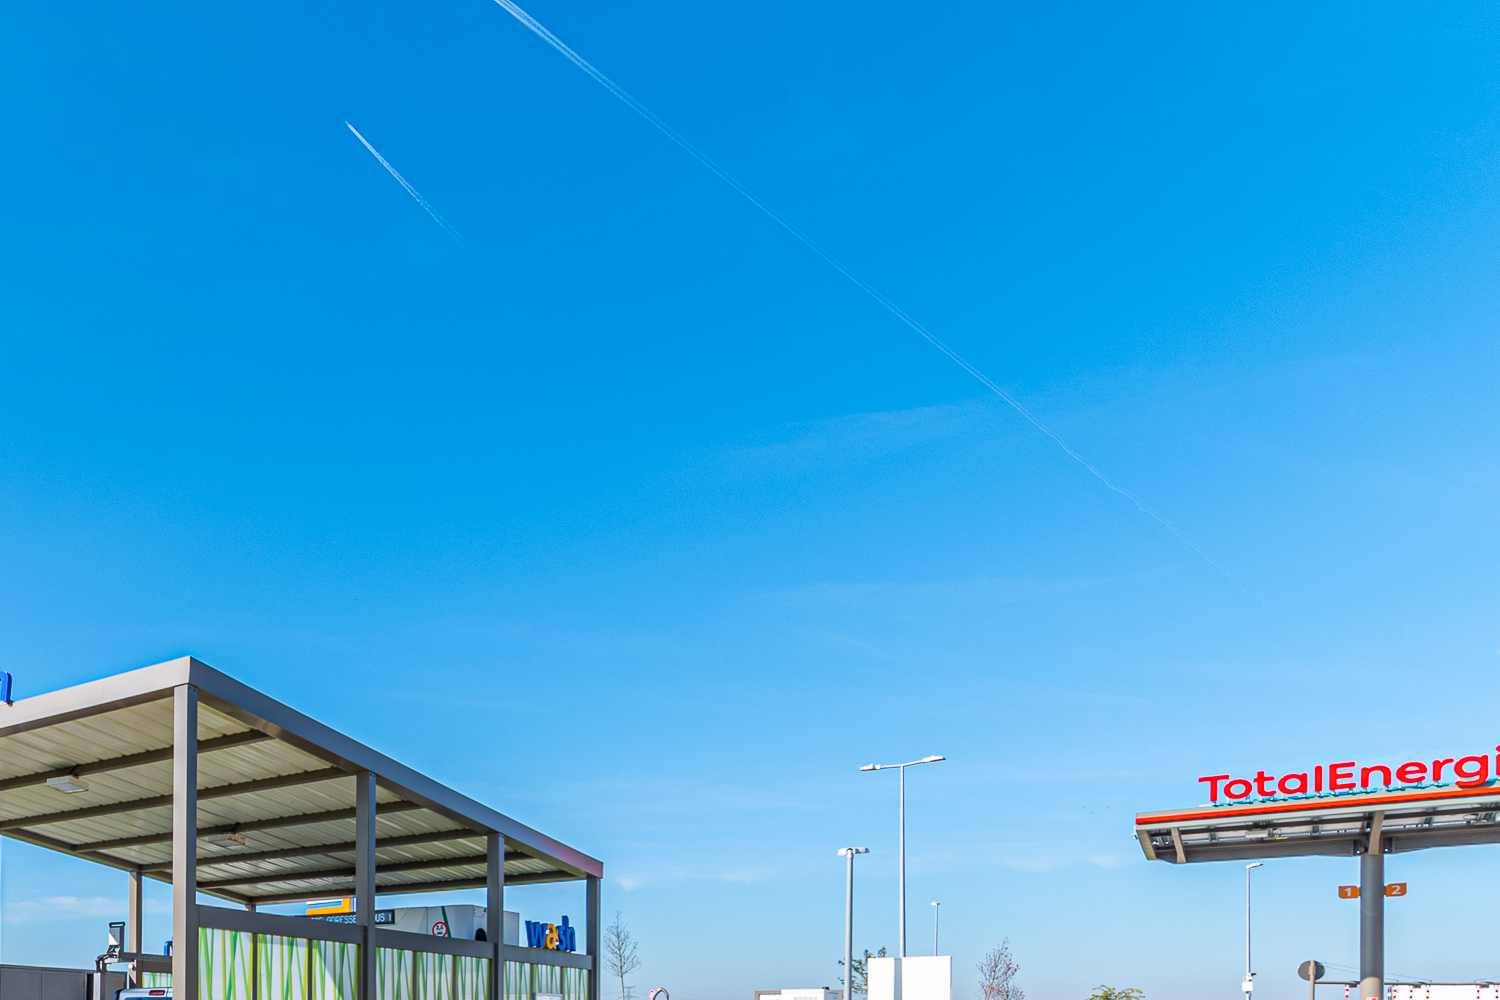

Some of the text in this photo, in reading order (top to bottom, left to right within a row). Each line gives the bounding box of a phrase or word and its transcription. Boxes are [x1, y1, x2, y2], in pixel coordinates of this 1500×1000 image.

[1344, 887, 1352, 897] 1
[1391, 885, 1401, 895] 2
[525, 915, 576, 951] wash
